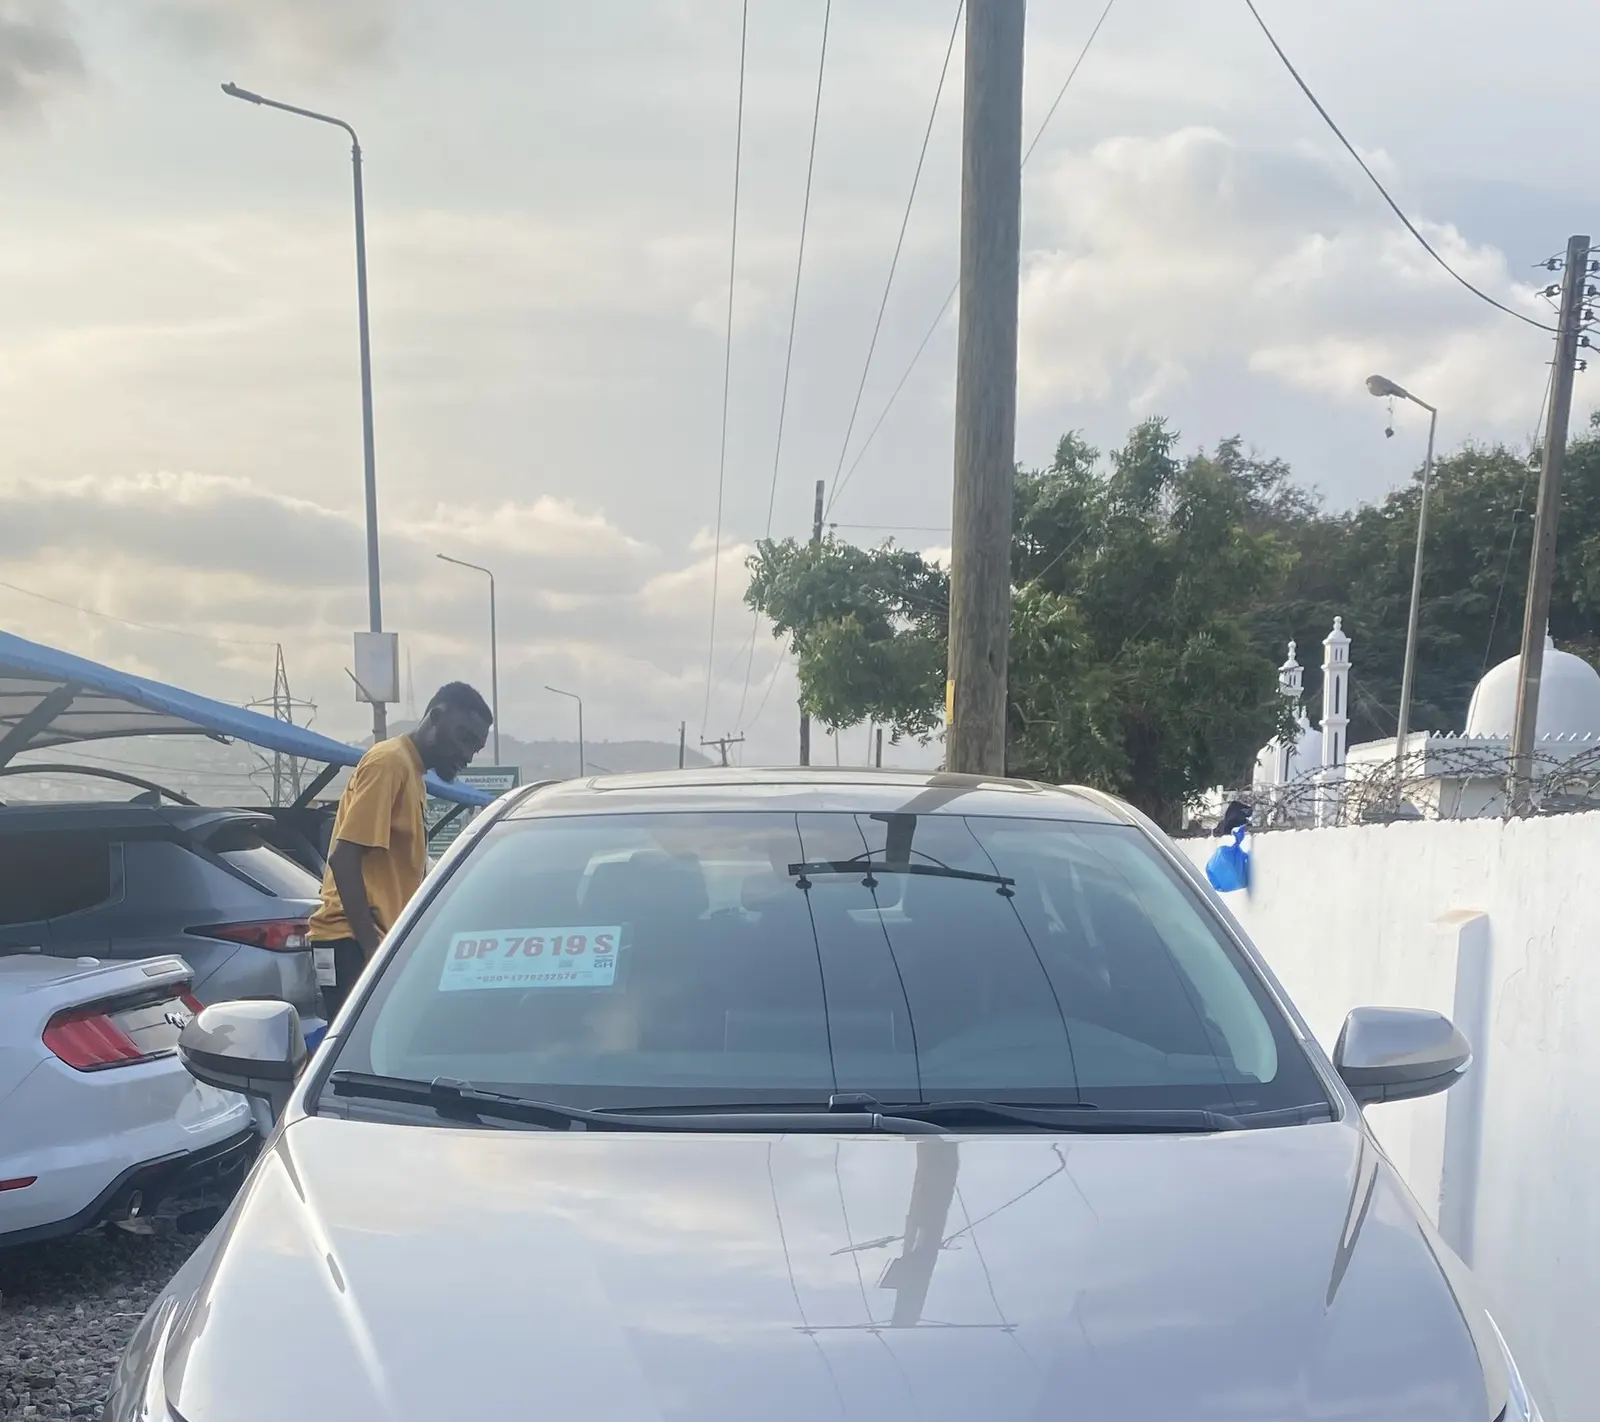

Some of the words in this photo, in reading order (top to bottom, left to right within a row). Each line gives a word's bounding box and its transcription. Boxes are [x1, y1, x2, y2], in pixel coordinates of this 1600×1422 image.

[455, 939, 498, 959] DP
[504, 935, 587, 957] 7619
[593, 934, 613, 954] S
